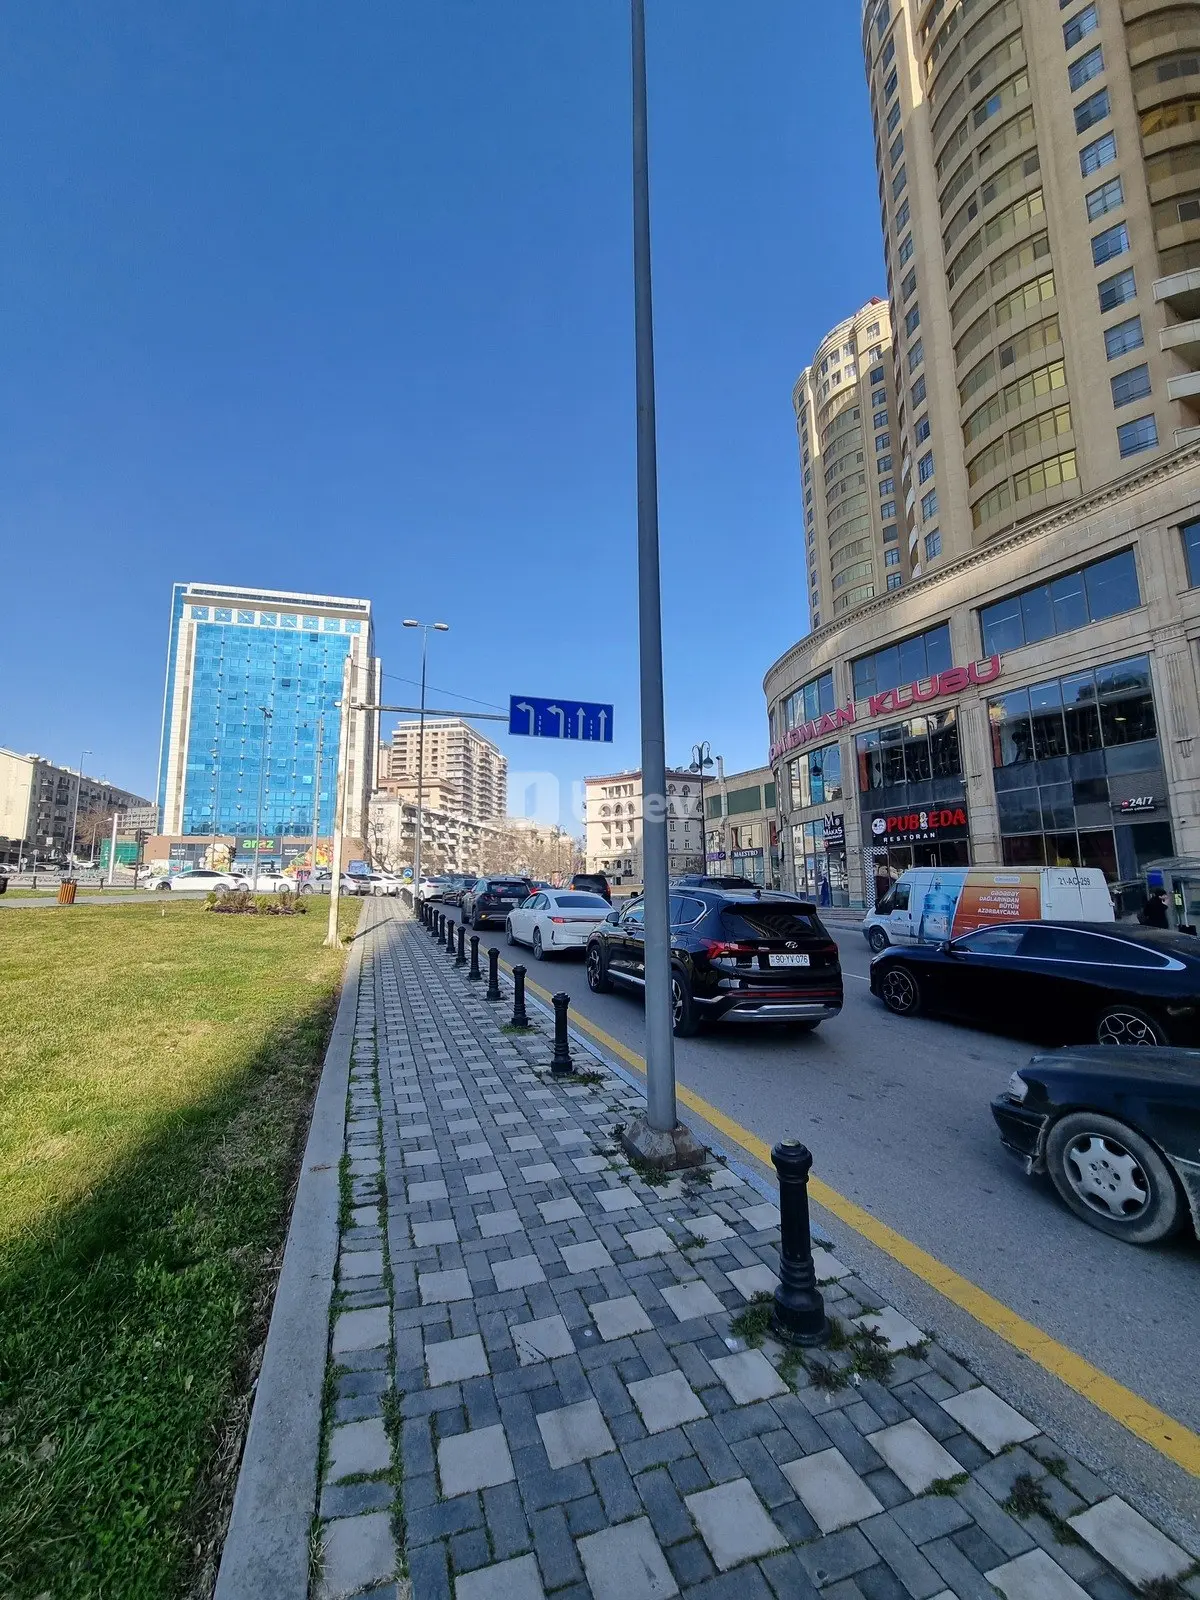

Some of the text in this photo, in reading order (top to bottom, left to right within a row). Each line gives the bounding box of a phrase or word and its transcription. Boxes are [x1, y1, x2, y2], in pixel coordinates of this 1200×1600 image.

[868, 654, 1001, 717] KLUBU
[1129, 796, 1153, 807] 24/7
[883, 832, 936, 843] RESTORAN
[242, 839, 274, 849] araz
